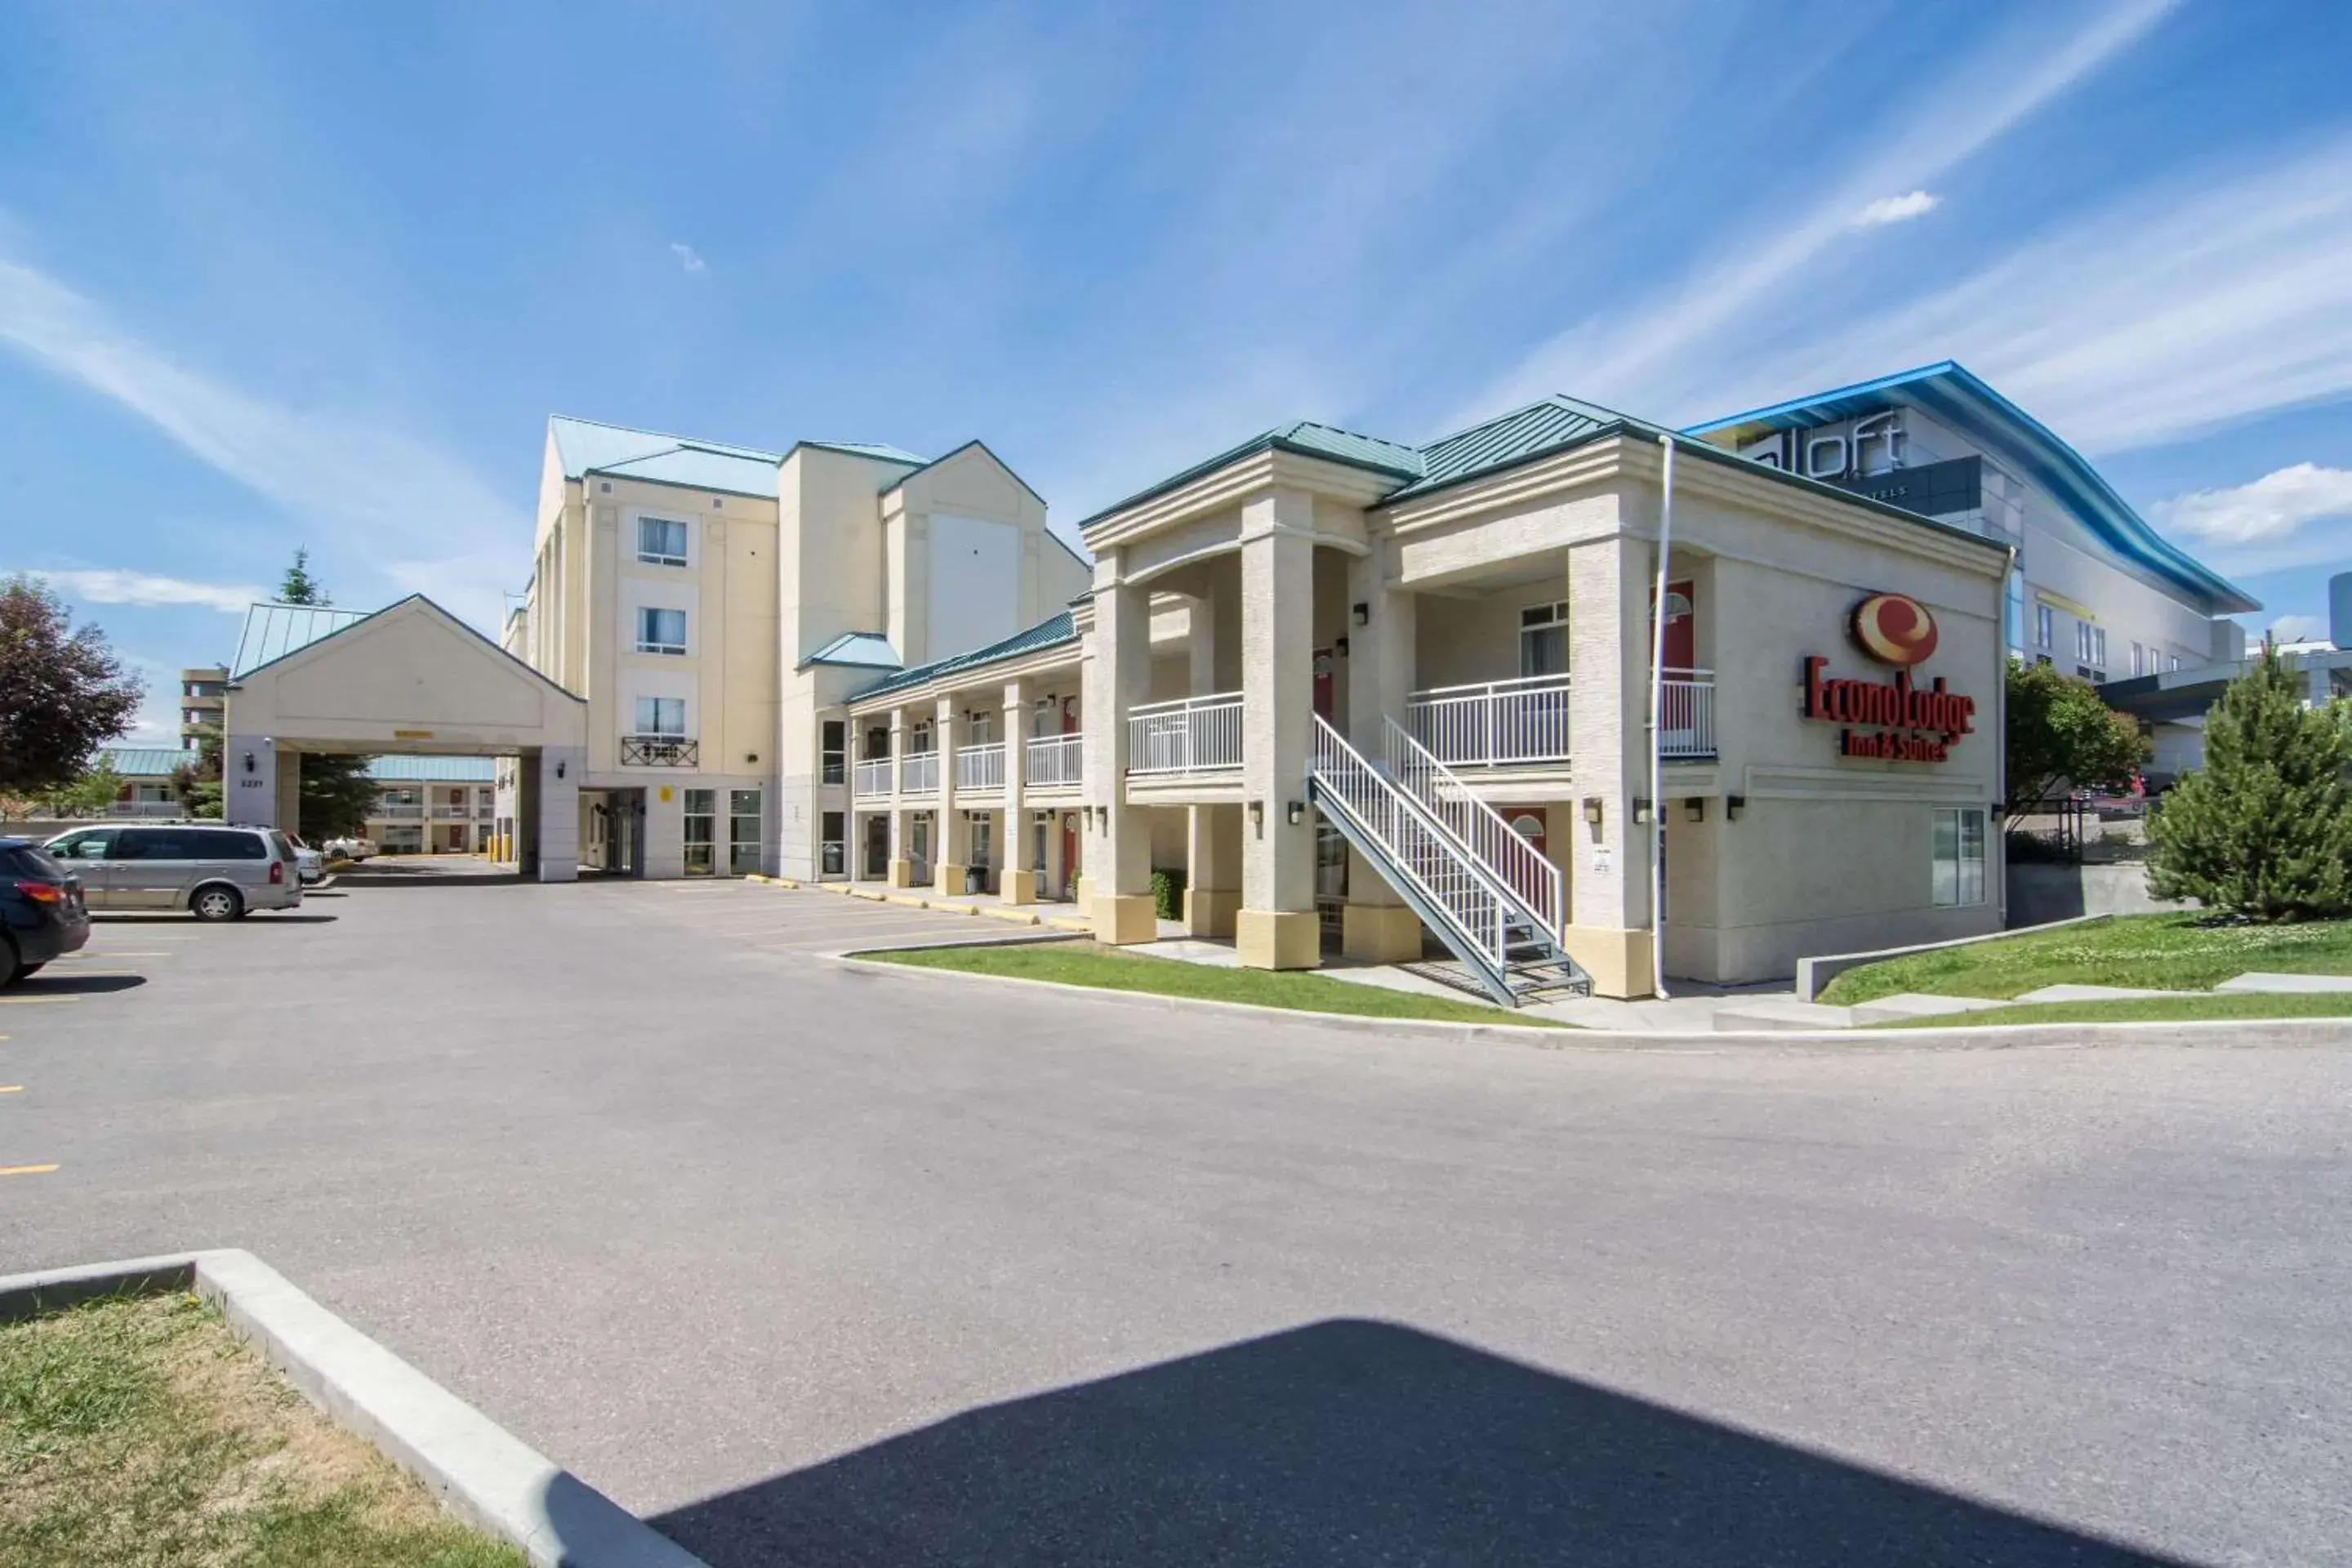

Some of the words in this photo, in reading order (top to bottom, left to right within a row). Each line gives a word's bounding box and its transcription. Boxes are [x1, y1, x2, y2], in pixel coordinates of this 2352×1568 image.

[1842, 729, 1878, 756] Inn
[1882, 732, 1895, 759] &
[1899, 734, 1947, 762] Suites
